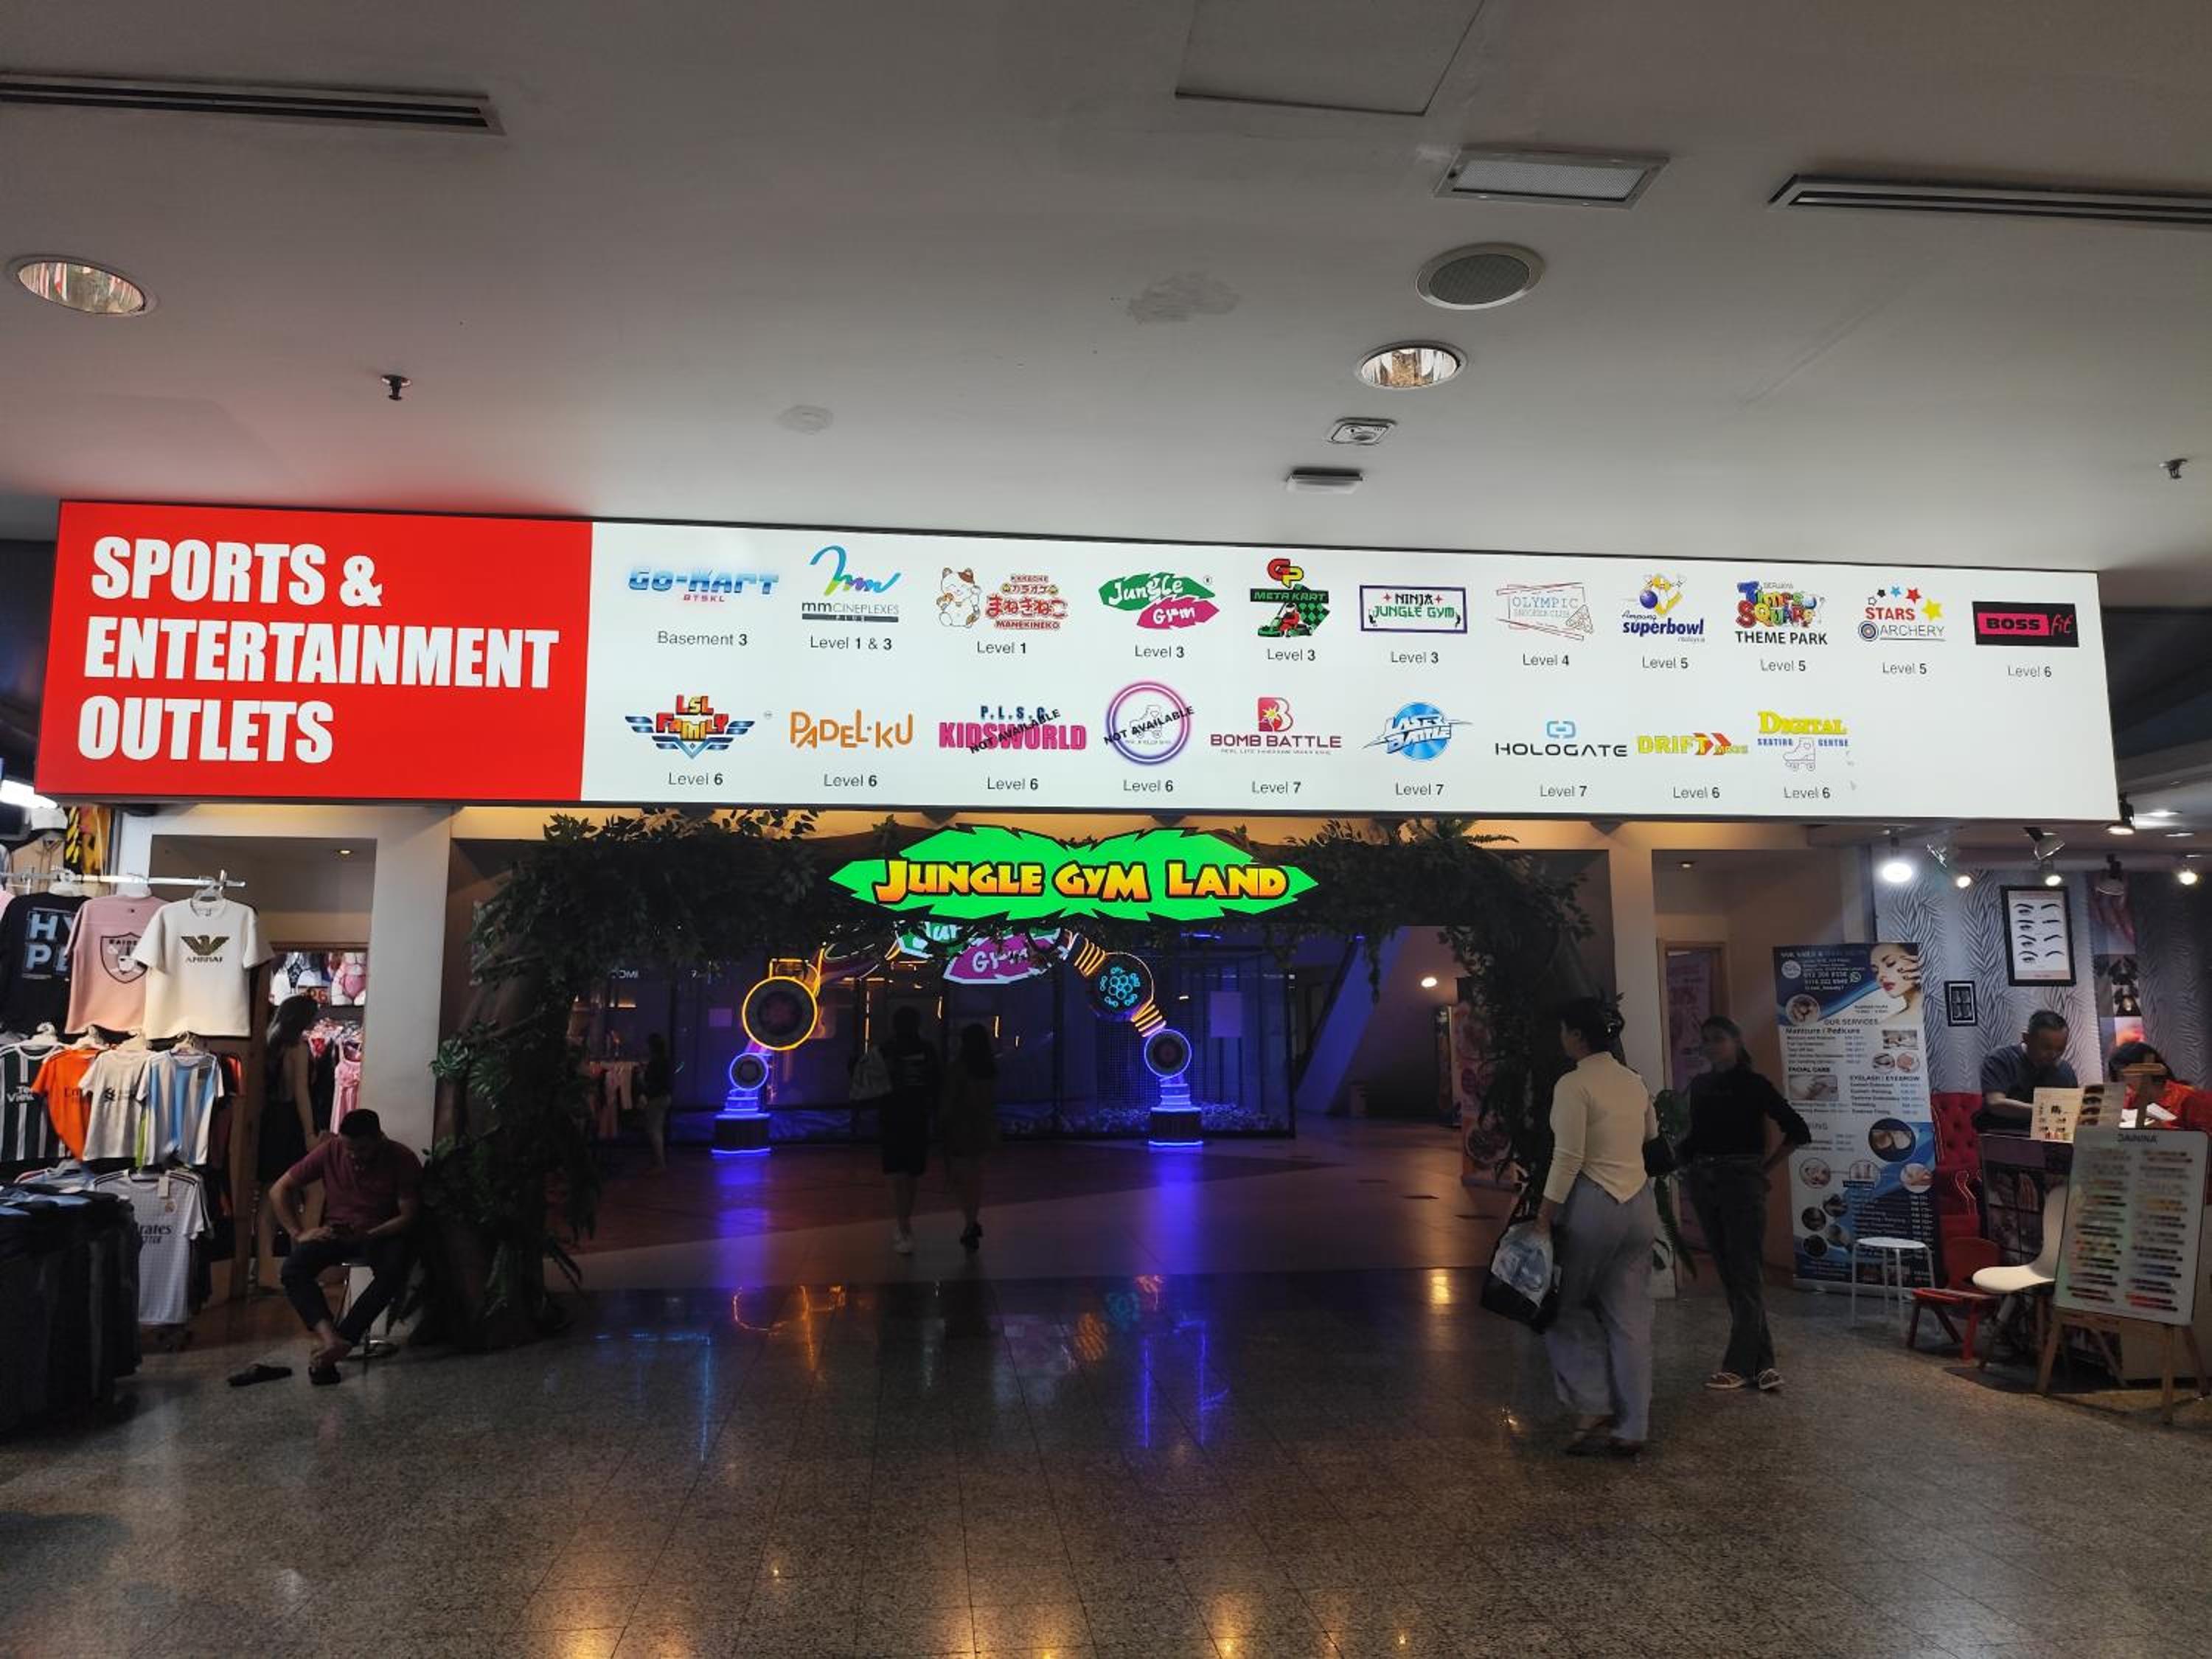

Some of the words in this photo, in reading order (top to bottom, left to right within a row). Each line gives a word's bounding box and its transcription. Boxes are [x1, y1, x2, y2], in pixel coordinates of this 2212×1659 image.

[91, 536, 327, 606] SPORTS
[339, 555, 383, 608] &
[628, 566, 779, 594] GO-KART
[1253, 591, 1290, 600] META
[1292, 593, 1326, 601] KART
[1395, 593, 1433, 605] NINJA
[1512, 597, 1579, 608] OLYMPIC
[986, 594, 1068, 617] まねきねこ
[1372, 605, 1422, 618] JUNGLE
[1865, 607, 1916, 620] STARS
[995, 620, 1060, 629] MANEKINEKO
[1623, 618, 1704, 637] superbowl
[1986, 617, 2041, 630] BOSS
[1735, 630, 1786, 644] THEME
[1790, 632, 1828, 644] PARK
[1879, 625, 1945, 637] ARCHERY
[658, 630, 734, 646] Basement
[738, 633, 748, 647] 3
[811, 636, 849, 649] Level
[855, 637, 860, 650] 1
[868, 638, 877, 650] &
[883, 638, 892, 650] 3
[83, 616, 560, 689] ENTERTAINMENT
[977, 641, 1015, 654] Level
[1020, 642, 1026, 654] 1
[1135, 645, 1172, 658] Level
[1176, 646, 1185, 658] 3
[1267, 648, 1303, 661] Level
[1307, 649, 1315, 661] 3
[1391, 651, 1427, 663] Level
[1431, 652, 1439, 664] 3
[1523, 653, 1558, 666] Level
[1561, 654, 1570, 666] 4
[1642, 655, 1676, 669] Level
[1680, 657, 1688, 669] 5
[1761, 659, 1794, 671] Level
[1798, 660, 1806, 672] 5
[1882, 662, 1916, 674] Level
[1919, 663, 1927, 675] 5
[2008, 666, 2040, 678] Level
[2044, 667, 2052, 678] 6
[675, 695, 714, 715] LSL
[77, 695, 334, 763] OUTLETS
[969, 737, 995, 754] NOT
[998, 709, 1060, 742] AVAILABLE
[1103, 729, 1127, 745] NOT
[1132, 706, 1194, 735] AVAILABLE
[939, 722, 1087, 750] KIDSWORLD
[1210, 734, 1262, 747] BOMB
[1267, 735, 1342, 748] BATTLE
[1495, 743, 1628, 757] HOLOGATE
[1637, 734, 1706, 754] DRIFT
[668, 772, 709, 785] Level
[714, 773, 723, 785] 6
[824, 774, 863, 787] Level
[869, 774, 877, 787] 6
[987, 777, 1026, 790] Level
[1030, 778, 1038, 790] 6
[1123, 779, 1161, 792] Level
[1165, 780, 1173, 792] 6
[1252, 781, 1288, 793] Level
[1293, 782, 1301, 793] 7
[1396, 783, 1431, 795] Level
[1436, 784, 1444, 795] 7
[1540, 785, 1574, 797] Level
[1579, 786, 1587, 796] 7
[1673, 787, 1708, 799] Level
[1711, 787, 1720, 799] 6
[1784, 787, 1818, 799] Level
[1822, 787, 1830, 799] 6
[875, 860, 1043, 902] JUNGLE
[1167, 862, 1287, 898] LAND
